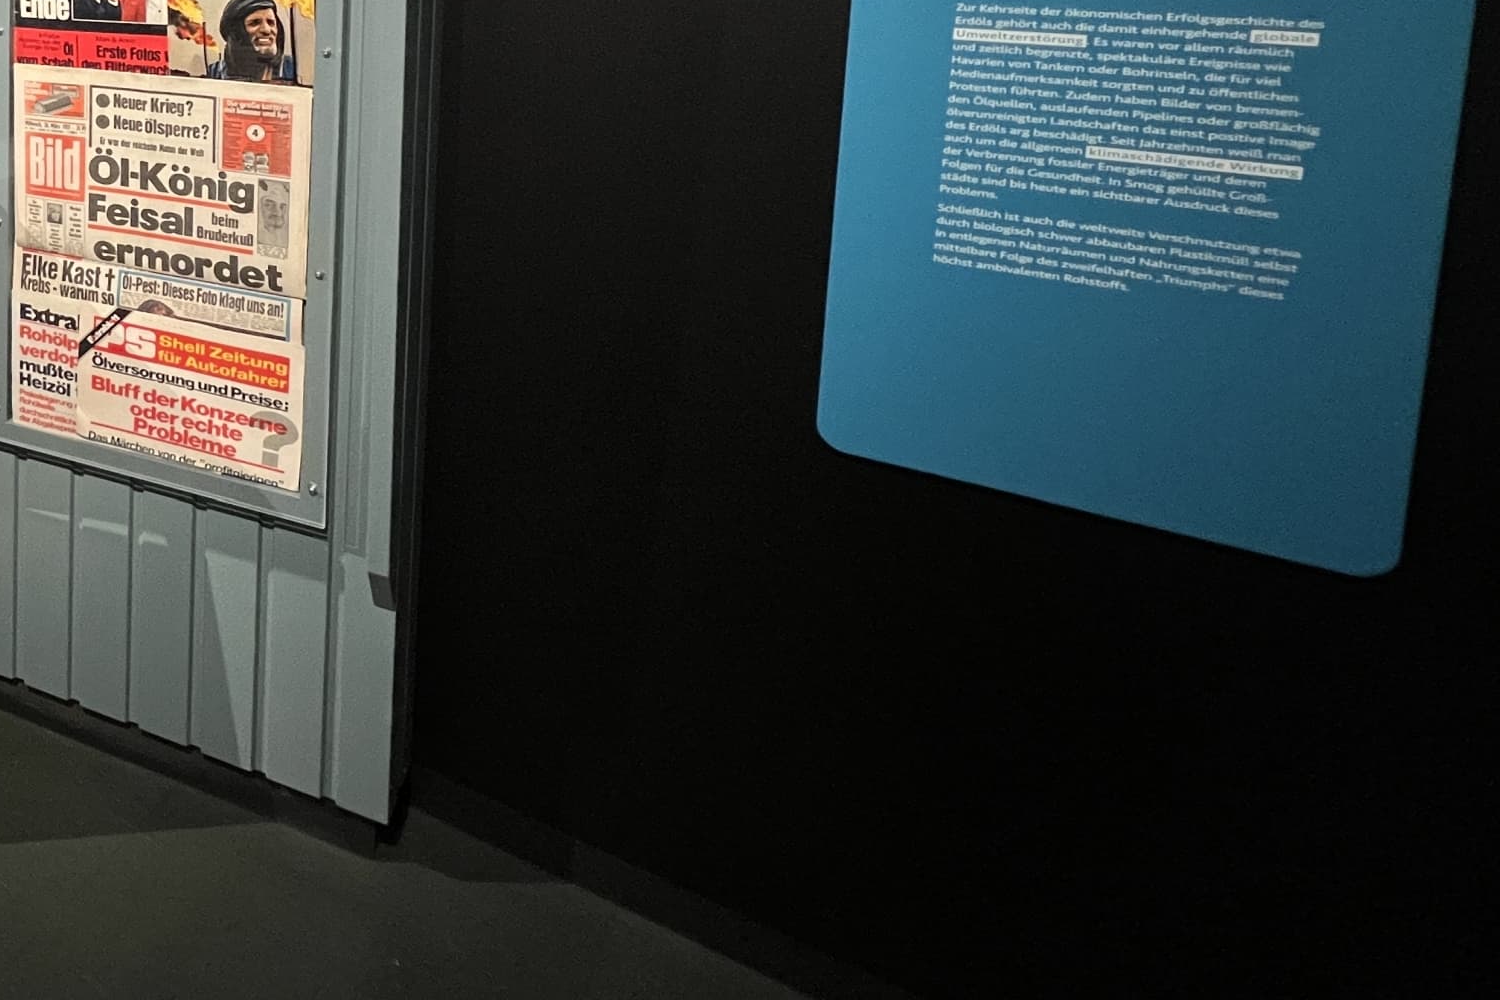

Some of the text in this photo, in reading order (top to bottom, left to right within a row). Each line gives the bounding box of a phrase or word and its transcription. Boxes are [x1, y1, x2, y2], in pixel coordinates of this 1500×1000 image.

[96, 45, 162, 62] Erste Fotos
[1255, 33, 1315, 46] globale
[113, 94, 194, 116] Neuer Krieg?
[113, 114, 210, 140] Neue Ölsperre?
[30, 136, 82, 192] Bild
[88, 148, 255, 214] Öl-König
[1090, 147, 1298, 178] klimaschädigende Wirkung
[88, 194, 193, 237] Feisal
[212, 212, 238, 229] beim
[196, 222, 254, 247] Bruderkuß
[22, 253, 100, 288] Elke Kast
[94, 241, 283, 292] ermordet
[933, 254, 974, 268] höchst
[976, 260, 1061, 281] ambivalenten
[20, 274, 114, 306] Krebs warum so
[122, 274, 284, 318] Öl-Pest: Dieses Foto klagt uns an!
[95, 318, 156, 359] PS
[160, 336, 288, 377] Shell Zeitung
[20, 372, 71, 397] Heizöl
[92, 355, 289, 411] Ölversorgung und Preise:
[158, 349, 287, 388] für Autofahrer
[91, 374, 288, 435] Bluff der Konzerne
[129, 404, 244, 442] oder echte
[89, 430, 196, 466] Das Märchen von der
[133, 418, 237, 458] Probleme
